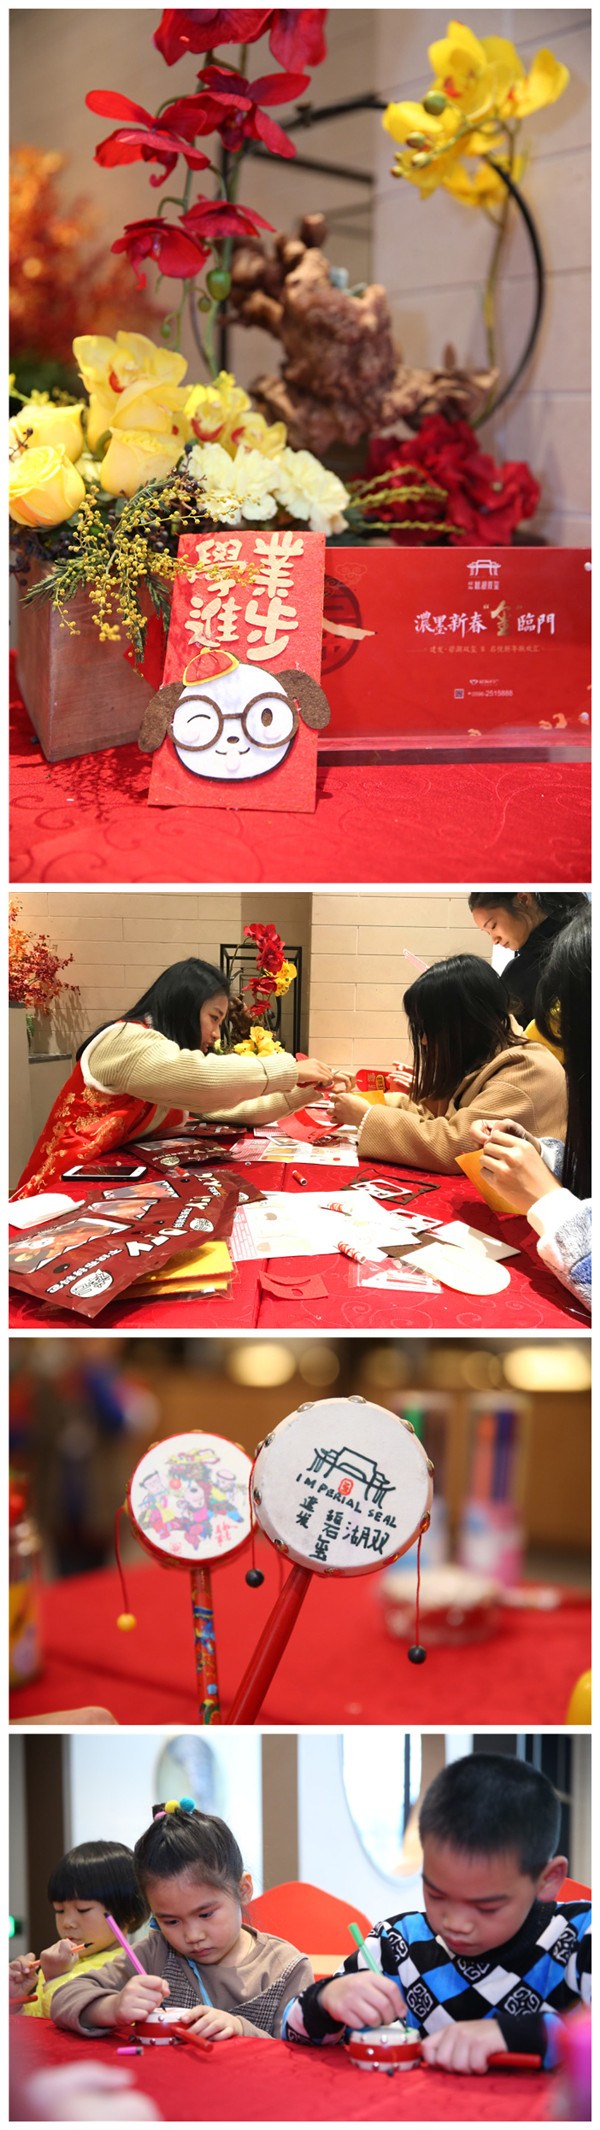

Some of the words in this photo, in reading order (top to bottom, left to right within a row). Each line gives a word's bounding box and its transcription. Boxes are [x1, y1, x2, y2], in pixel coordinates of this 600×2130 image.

[126, 1227, 188, 1257] DIY
[296, 1473, 362, 1514] IMPERIAL
[367, 1508, 397, 1529] SEAL
